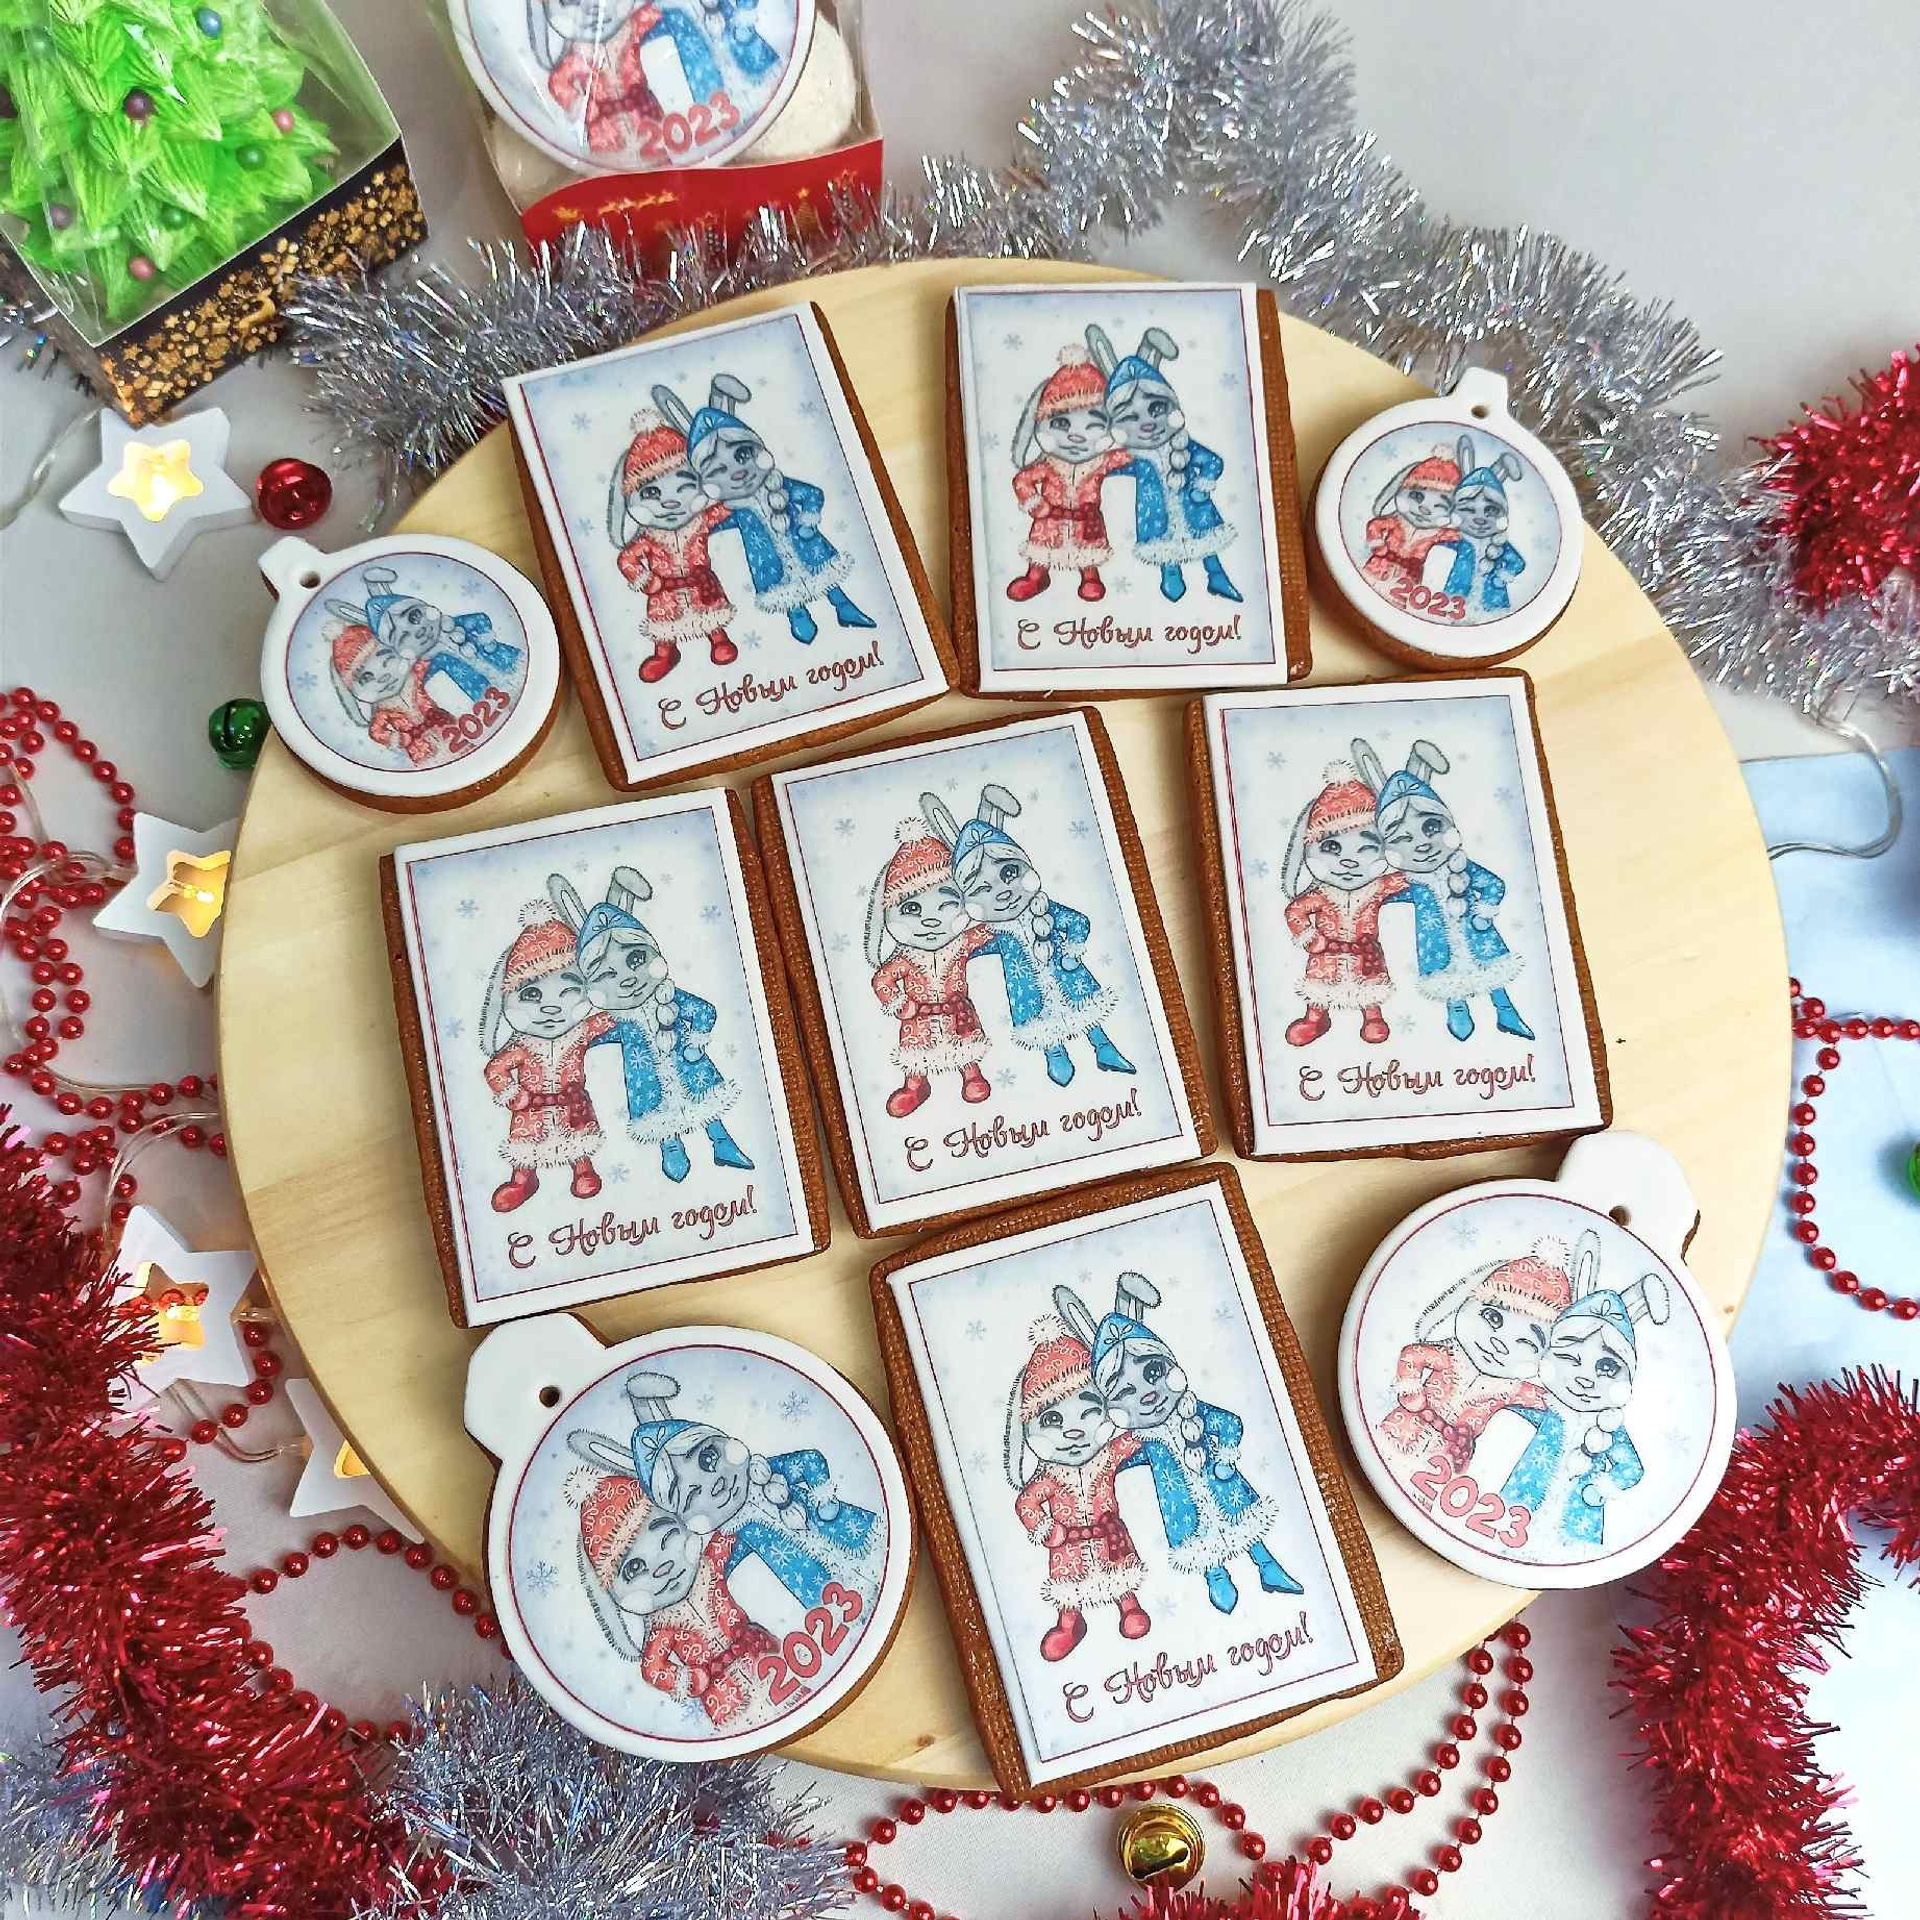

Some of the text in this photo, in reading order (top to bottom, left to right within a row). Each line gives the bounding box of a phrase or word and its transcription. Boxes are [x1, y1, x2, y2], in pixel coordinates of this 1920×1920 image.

[637, 90, 741, 161] 2023
[1017, 614, 1241, 654] С Новым годом!
[1389, 577, 1466, 620] 2023
[442, 687, 511, 752] 2023
[658, 641, 884, 730] С Новым годом!
[1299, 1053, 1536, 1101] С Новым годом!
[905, 1088, 1142, 1172] С Новым годом!
[508, 1185, 758, 1269] С Новым годом!
[1410, 1455, 1531, 1548] 2023
[758, 1582, 863, 1706] 2023
[1063, 1611, 1313, 1723] С Новым годом!
